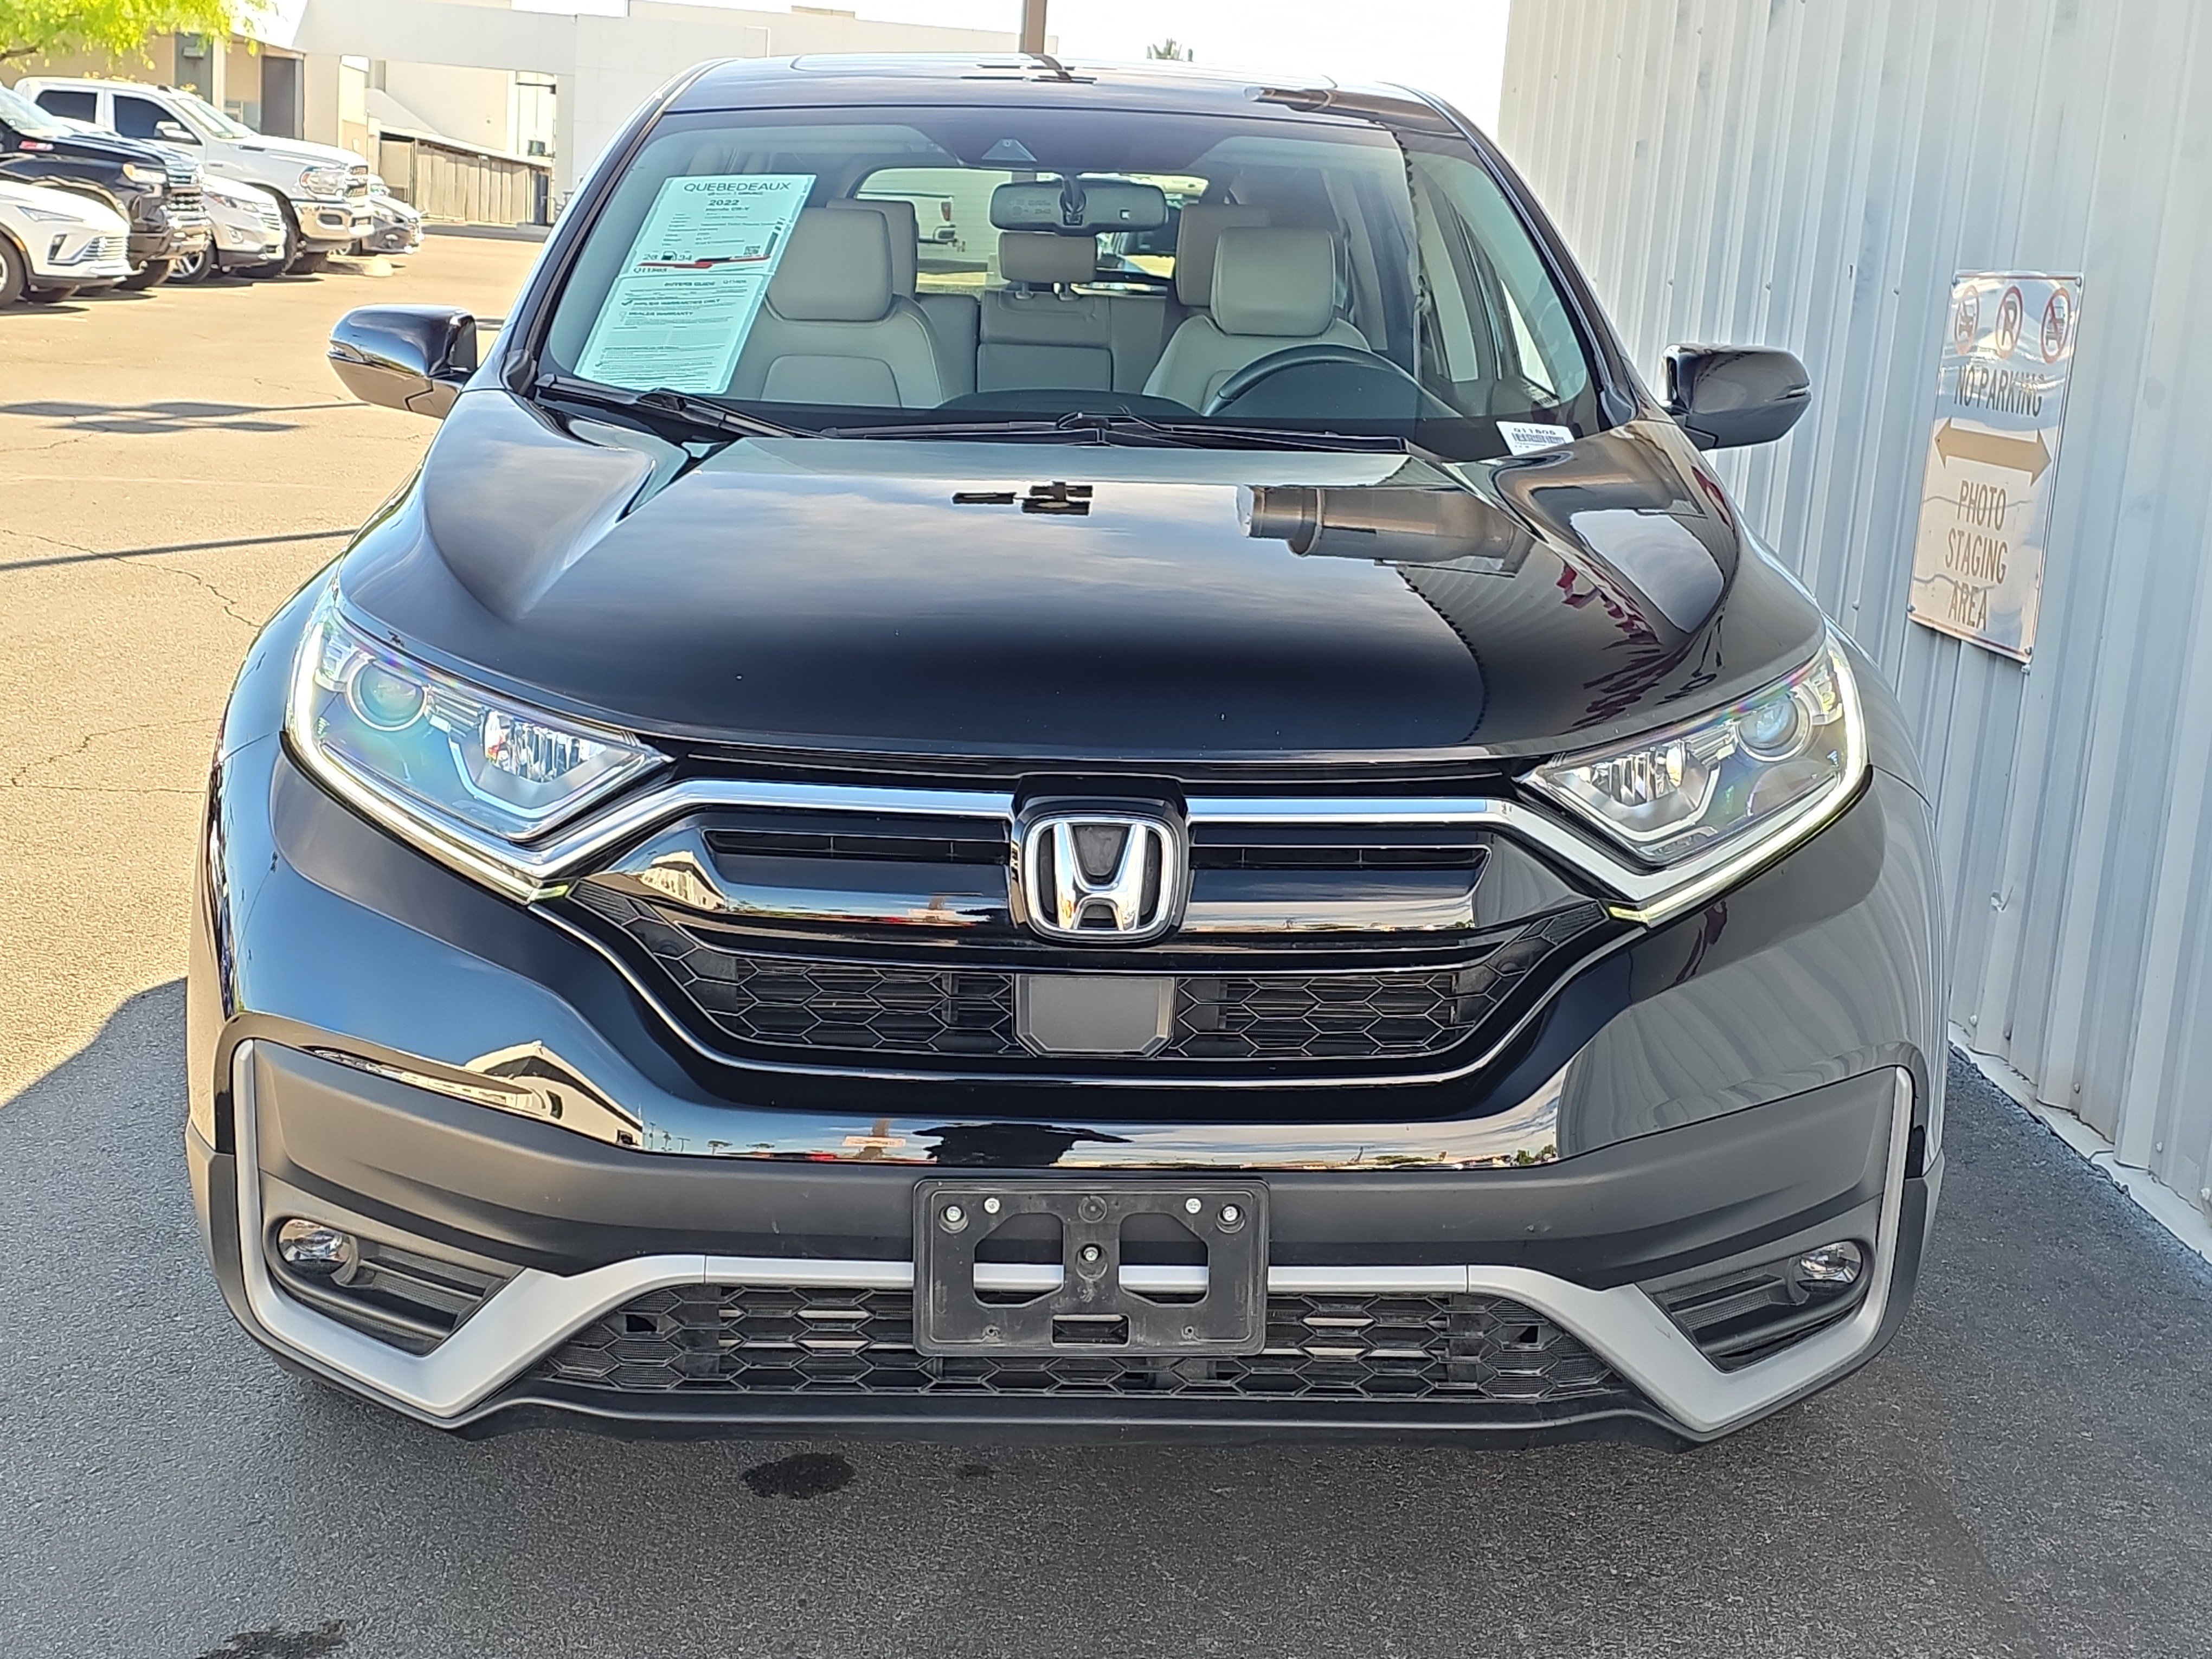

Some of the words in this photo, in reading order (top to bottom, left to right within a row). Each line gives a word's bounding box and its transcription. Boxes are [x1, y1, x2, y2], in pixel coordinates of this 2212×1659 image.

[684, 182, 792, 192] QUEBEDEAUX
[1954, 364, 1975, 407] NO
[1976, 367, 2044, 417] PARKING
[1957, 480, 2007, 531] PHOTO
[1945, 528, 2008, 584] STAGING
[1948, 580, 1987, 632] AREA
